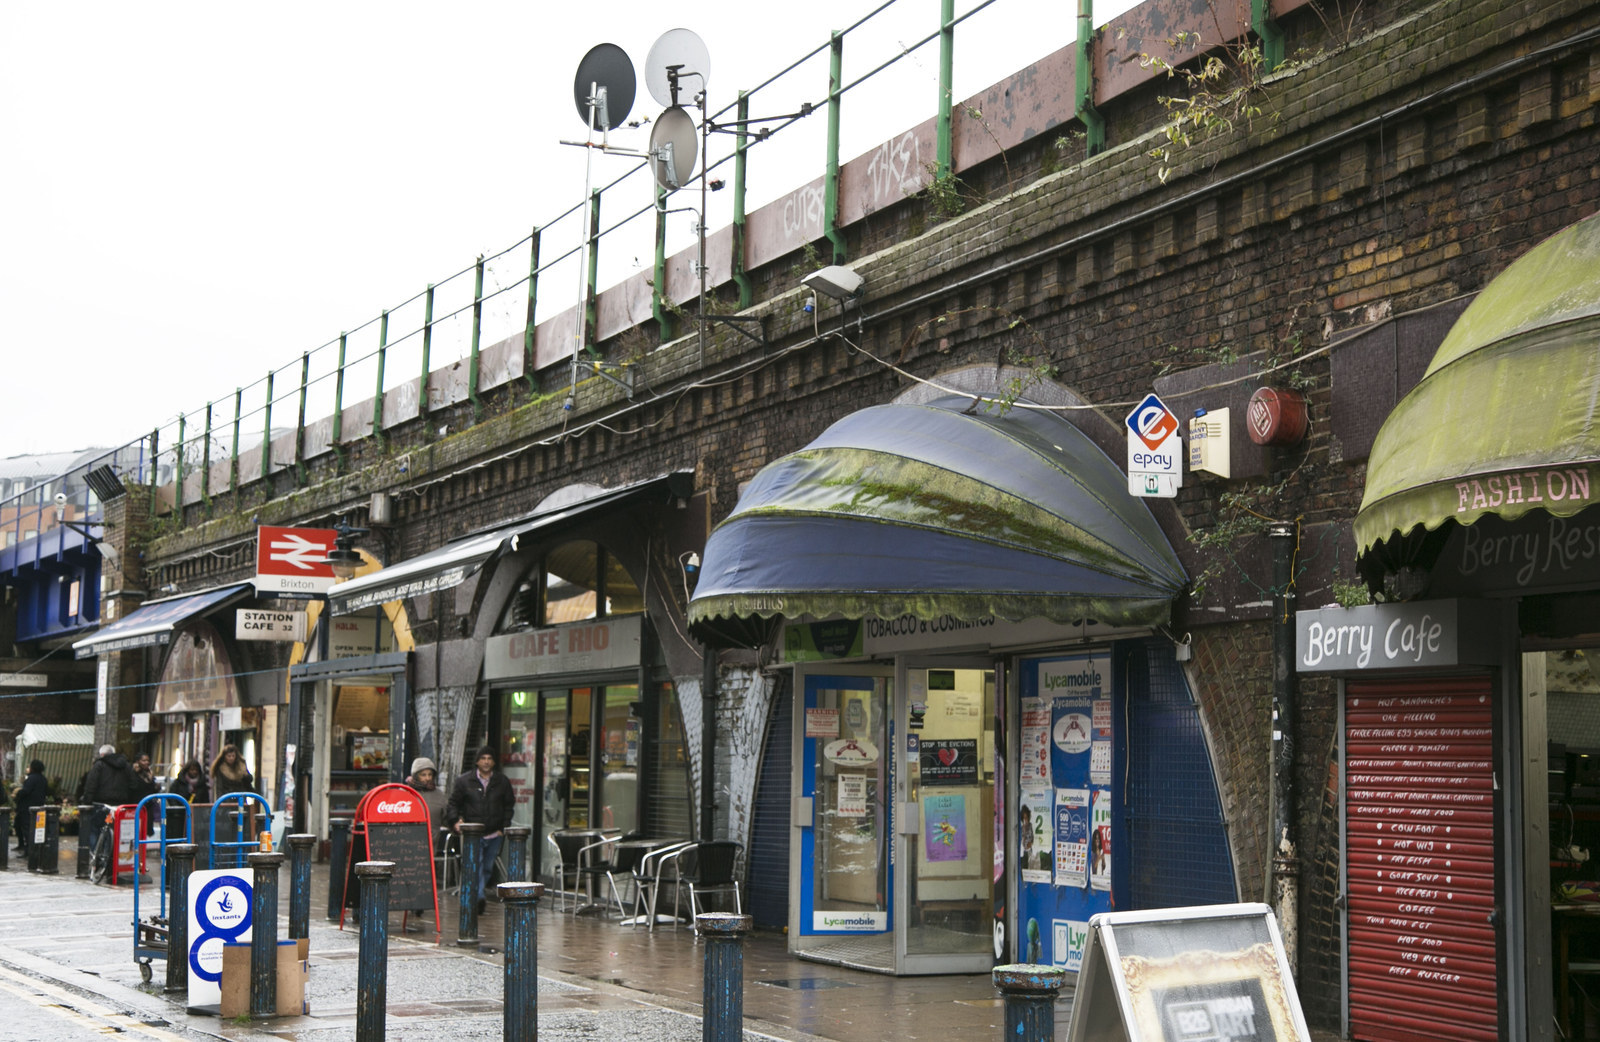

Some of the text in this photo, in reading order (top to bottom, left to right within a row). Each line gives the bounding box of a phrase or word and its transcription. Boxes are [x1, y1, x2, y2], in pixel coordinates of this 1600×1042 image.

[1133, 453, 1172, 470] epay
[1455, 468, 1590, 513] FASHION
[1457, 517, 1600, 586] Berry Res
[280, 579, 315, 590] Brixton
[244, 612, 294, 622] STATION
[244, 622, 274, 631] CAFE
[866, 616, 917, 639] TOBACCO
[509, 624, 610, 660] CAFE RIO
[1303, 615, 1442, 669] Berry Cafe
[1045, 669, 1102, 692] Lycamobile
[1400, 696, 1452, 705] SANDWICHES
[1382, 713, 1398, 722] ONE
[1350, 728, 1371, 738] THREE
[949, 740, 975, 748] EVICTIONS
[1357, 806, 1385, 814] CHICKEN
[1035, 814, 1044, 835] 2
[1391, 823, 1438, 833] COW FOOT
[1393, 840, 1414, 849] HOT
[1406, 856, 1433, 865] FISH
[1389, 871, 1439, 882] GOAT SOUP
[1395, 887, 1415, 896] RICE
[1398, 904, 1437, 915] COFFEE
[824, 917, 876, 927] Lycamobile
[1366, 916, 1385, 925] TUNA
[1397, 935, 1443, 947] HOT FOOD
[1422, 955, 1448, 965] RICE
[1417, 970, 1460, 983] BURGER
[1216, 1012, 1257, 1037] ART
